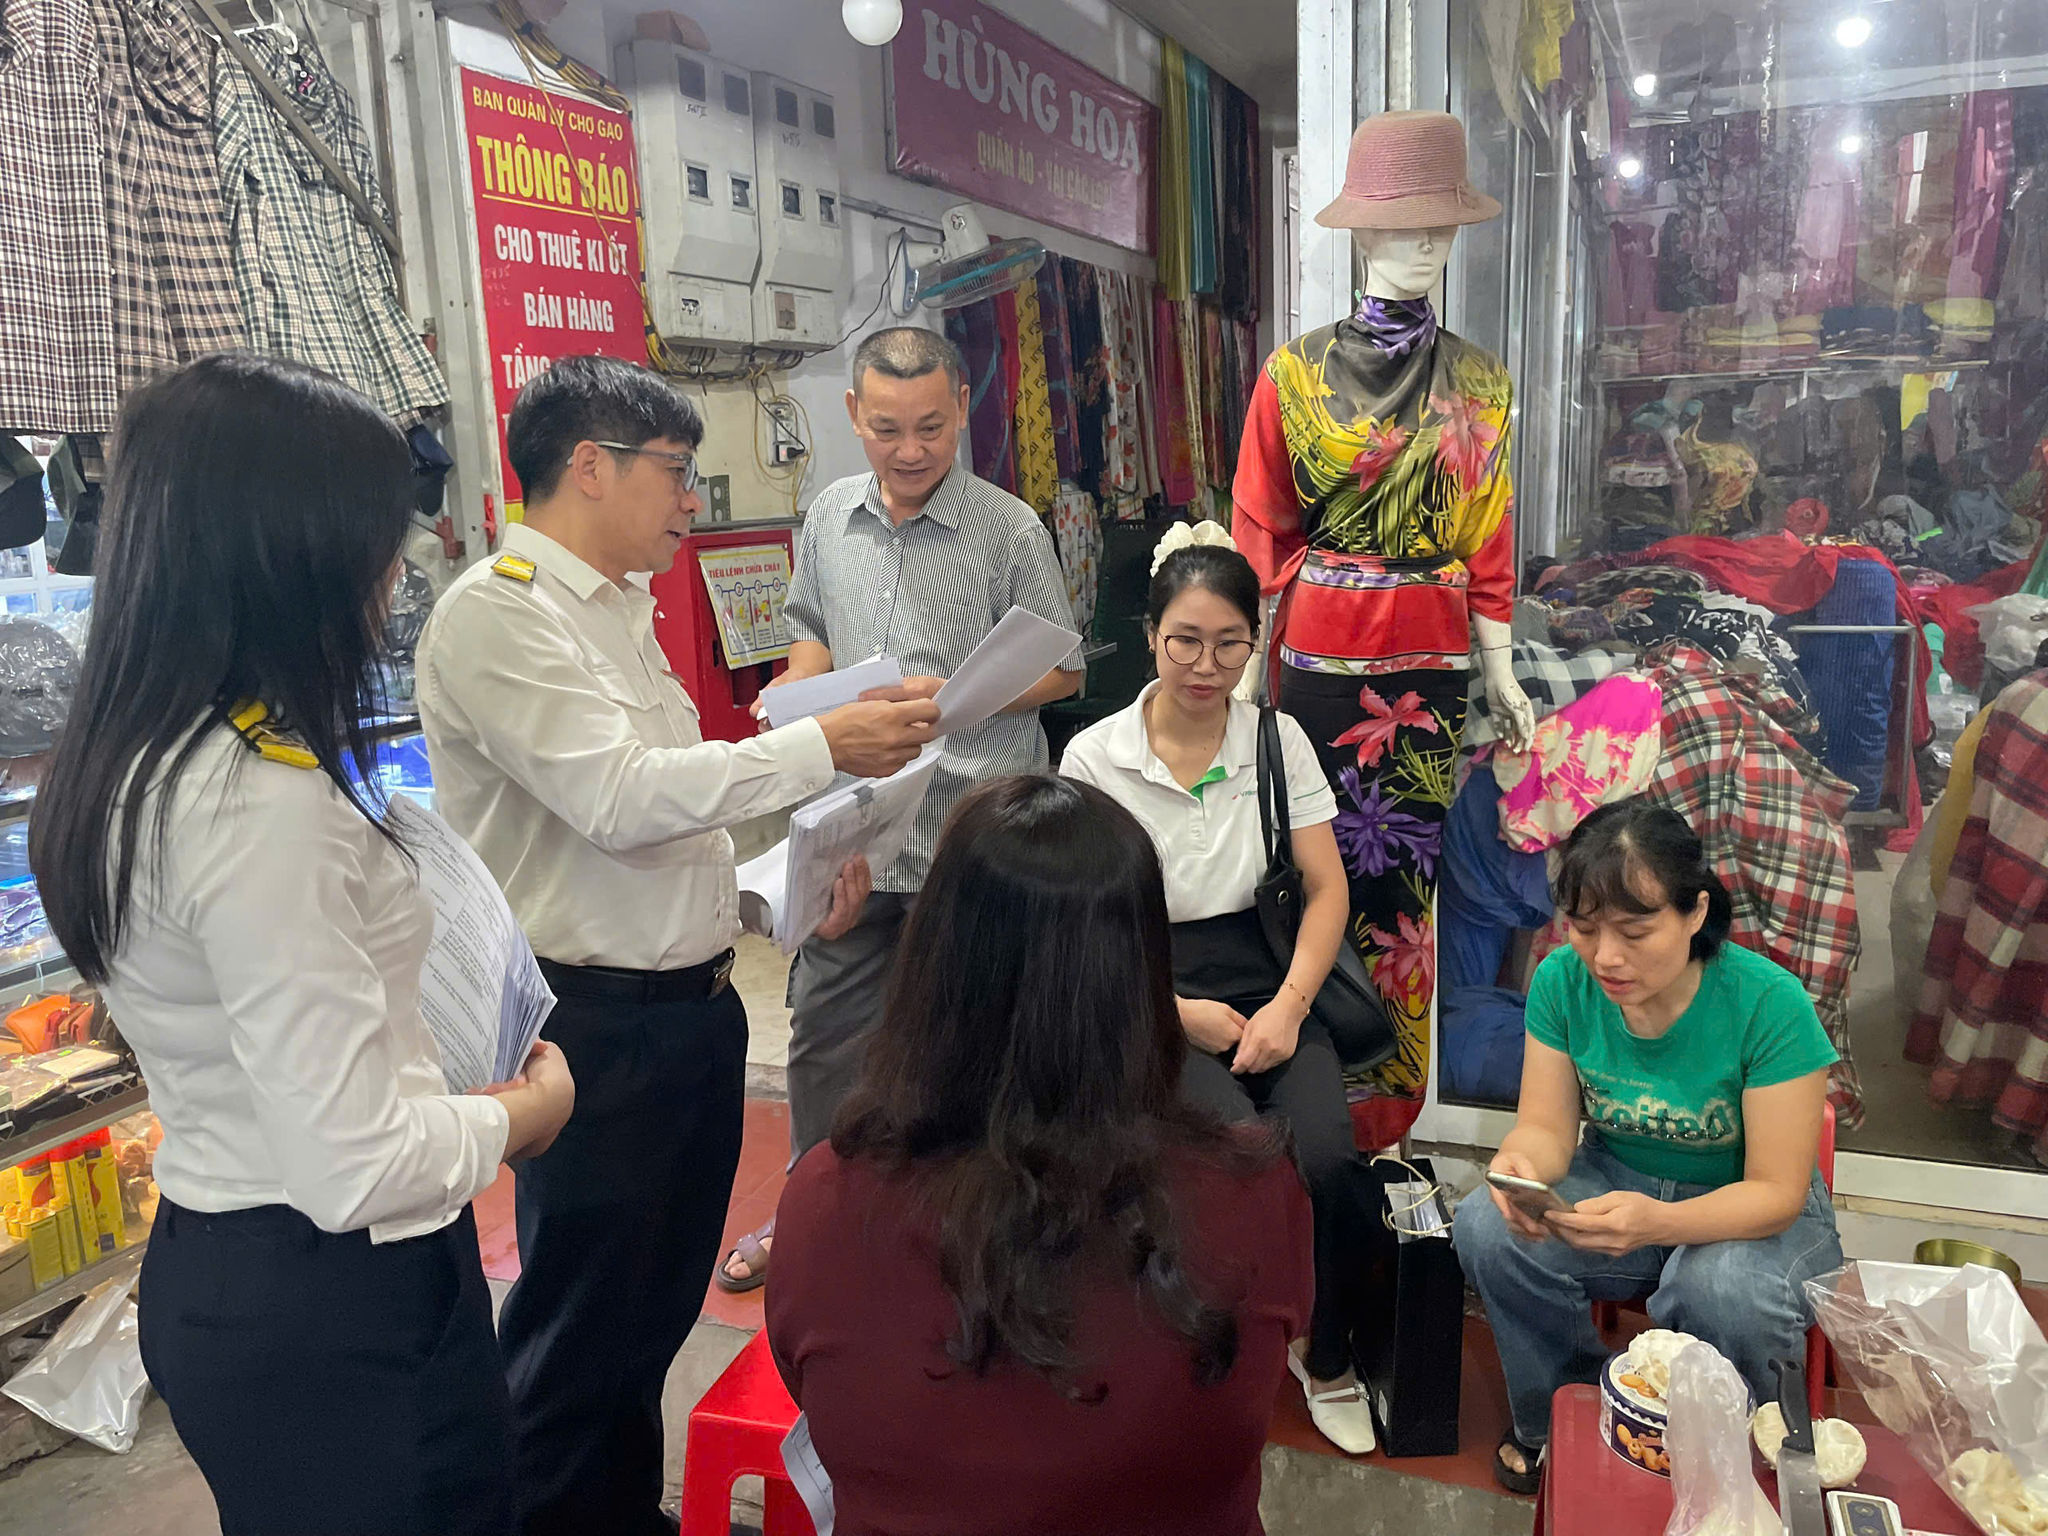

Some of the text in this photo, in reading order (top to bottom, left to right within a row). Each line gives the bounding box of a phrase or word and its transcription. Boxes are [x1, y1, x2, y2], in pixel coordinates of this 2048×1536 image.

[473, 86, 503, 111] BAN
[507, 93, 546, 123] QUẢN
[569, 113, 595, 141] CHỢ
[598, 118, 624, 142] GẠO
[922, 9, 1142, 176] HÙNG HOA
[476, 133, 629, 216] THÔNG BÁO
[494, 223, 628, 276] CHO THUÊ KI ỐT
[523, 286, 563, 329] BÁN
[567, 290, 614, 333] HÀNG
